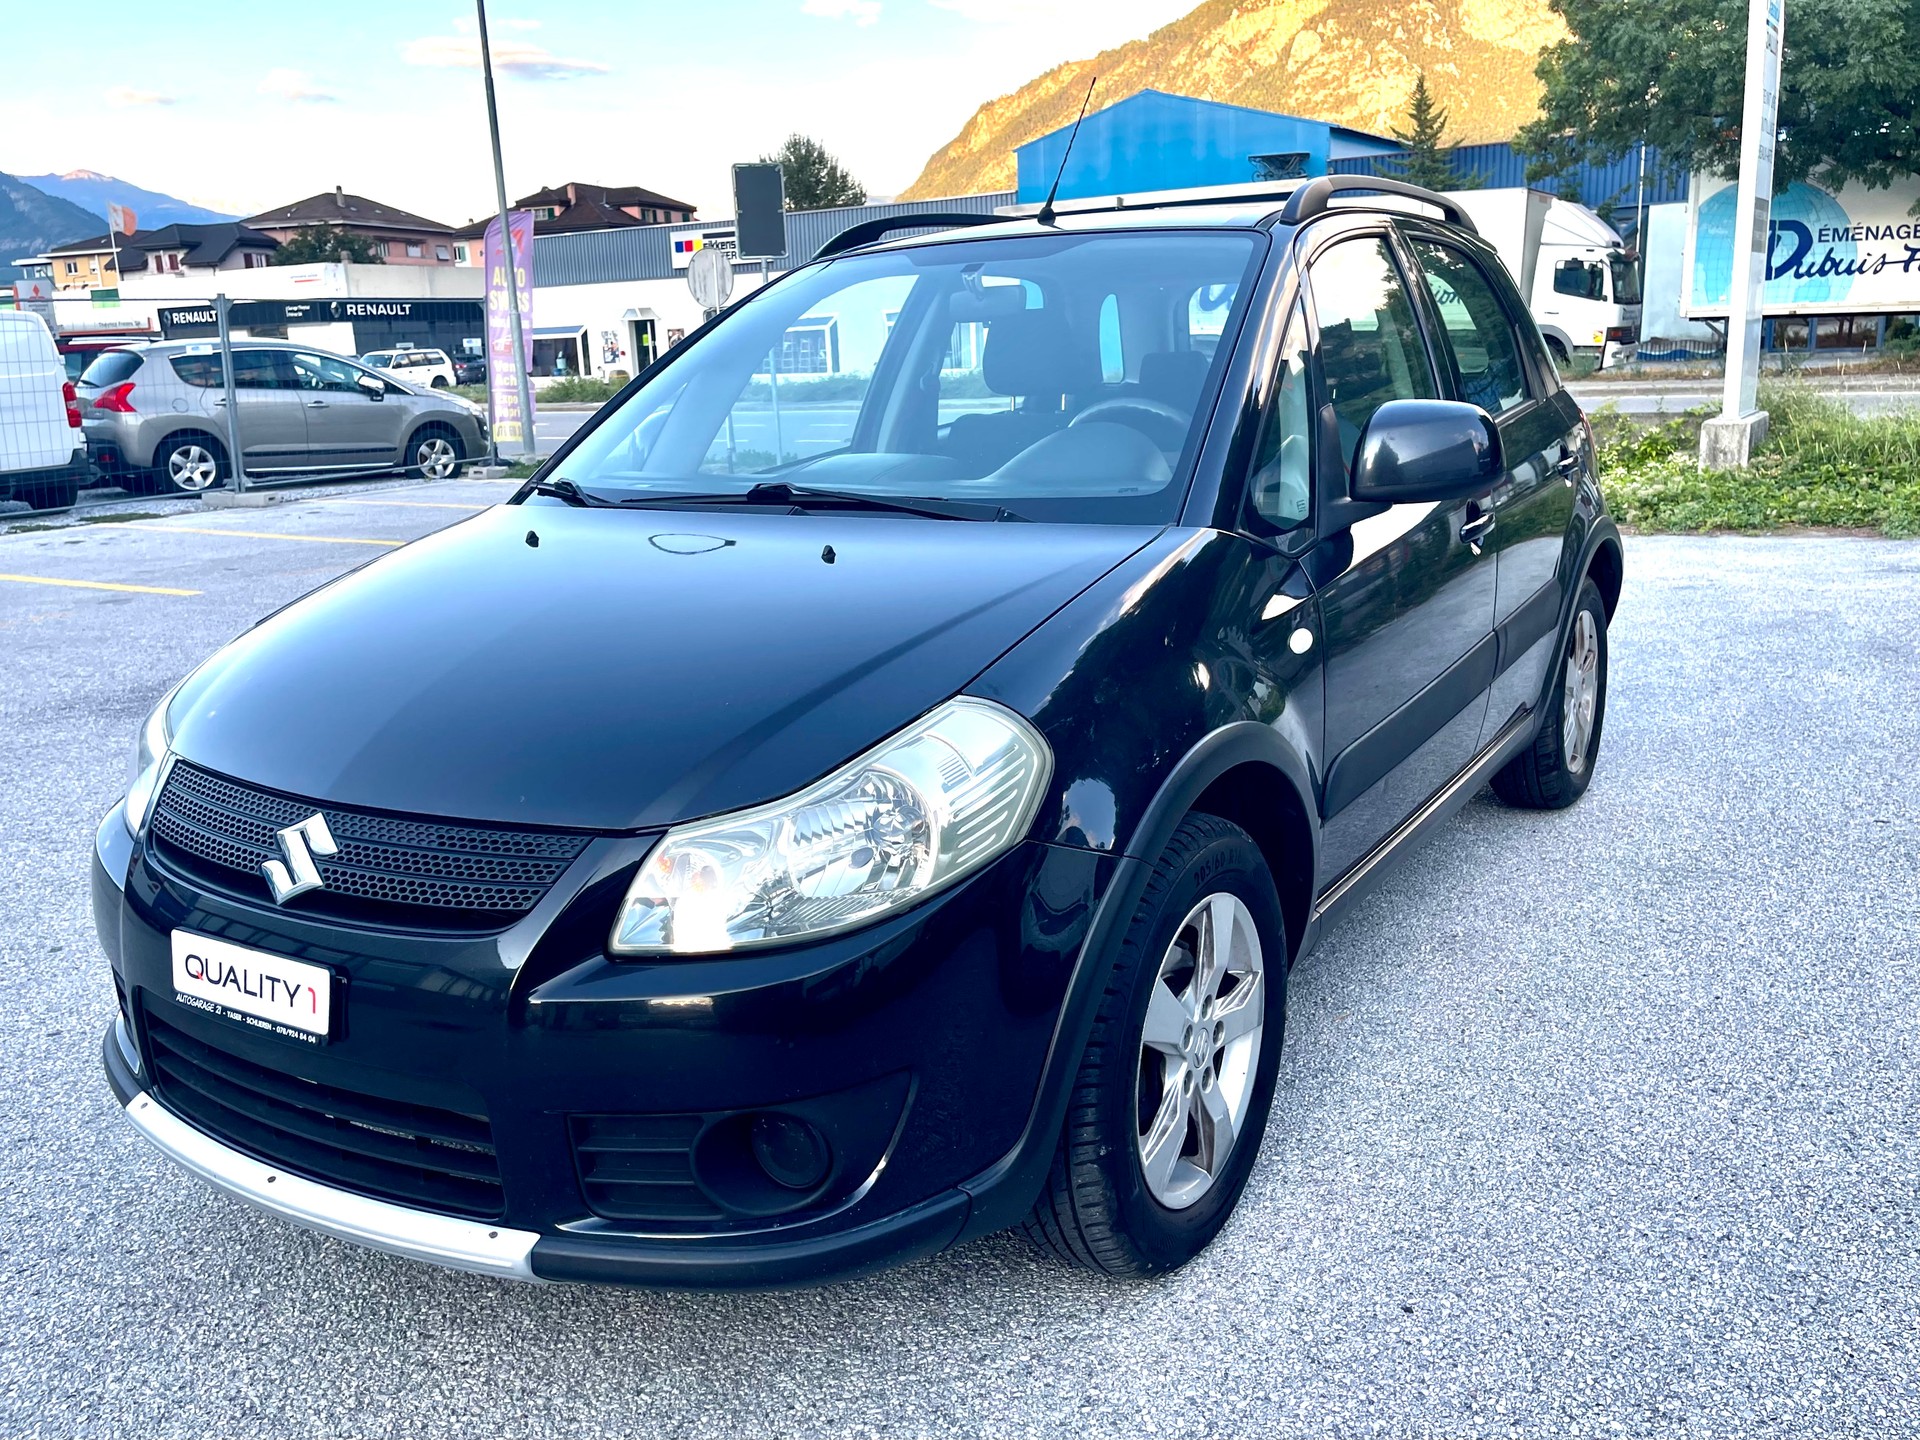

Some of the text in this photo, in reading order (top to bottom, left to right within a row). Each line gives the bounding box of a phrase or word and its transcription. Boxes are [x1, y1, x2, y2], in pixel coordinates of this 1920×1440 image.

[173, 309, 217, 324] RENAULT
[346, 303, 412, 316] RENAULT
[185, 954, 301, 1008] QUALITY
[176, 993, 215, 1013] AUTOGARAGE
